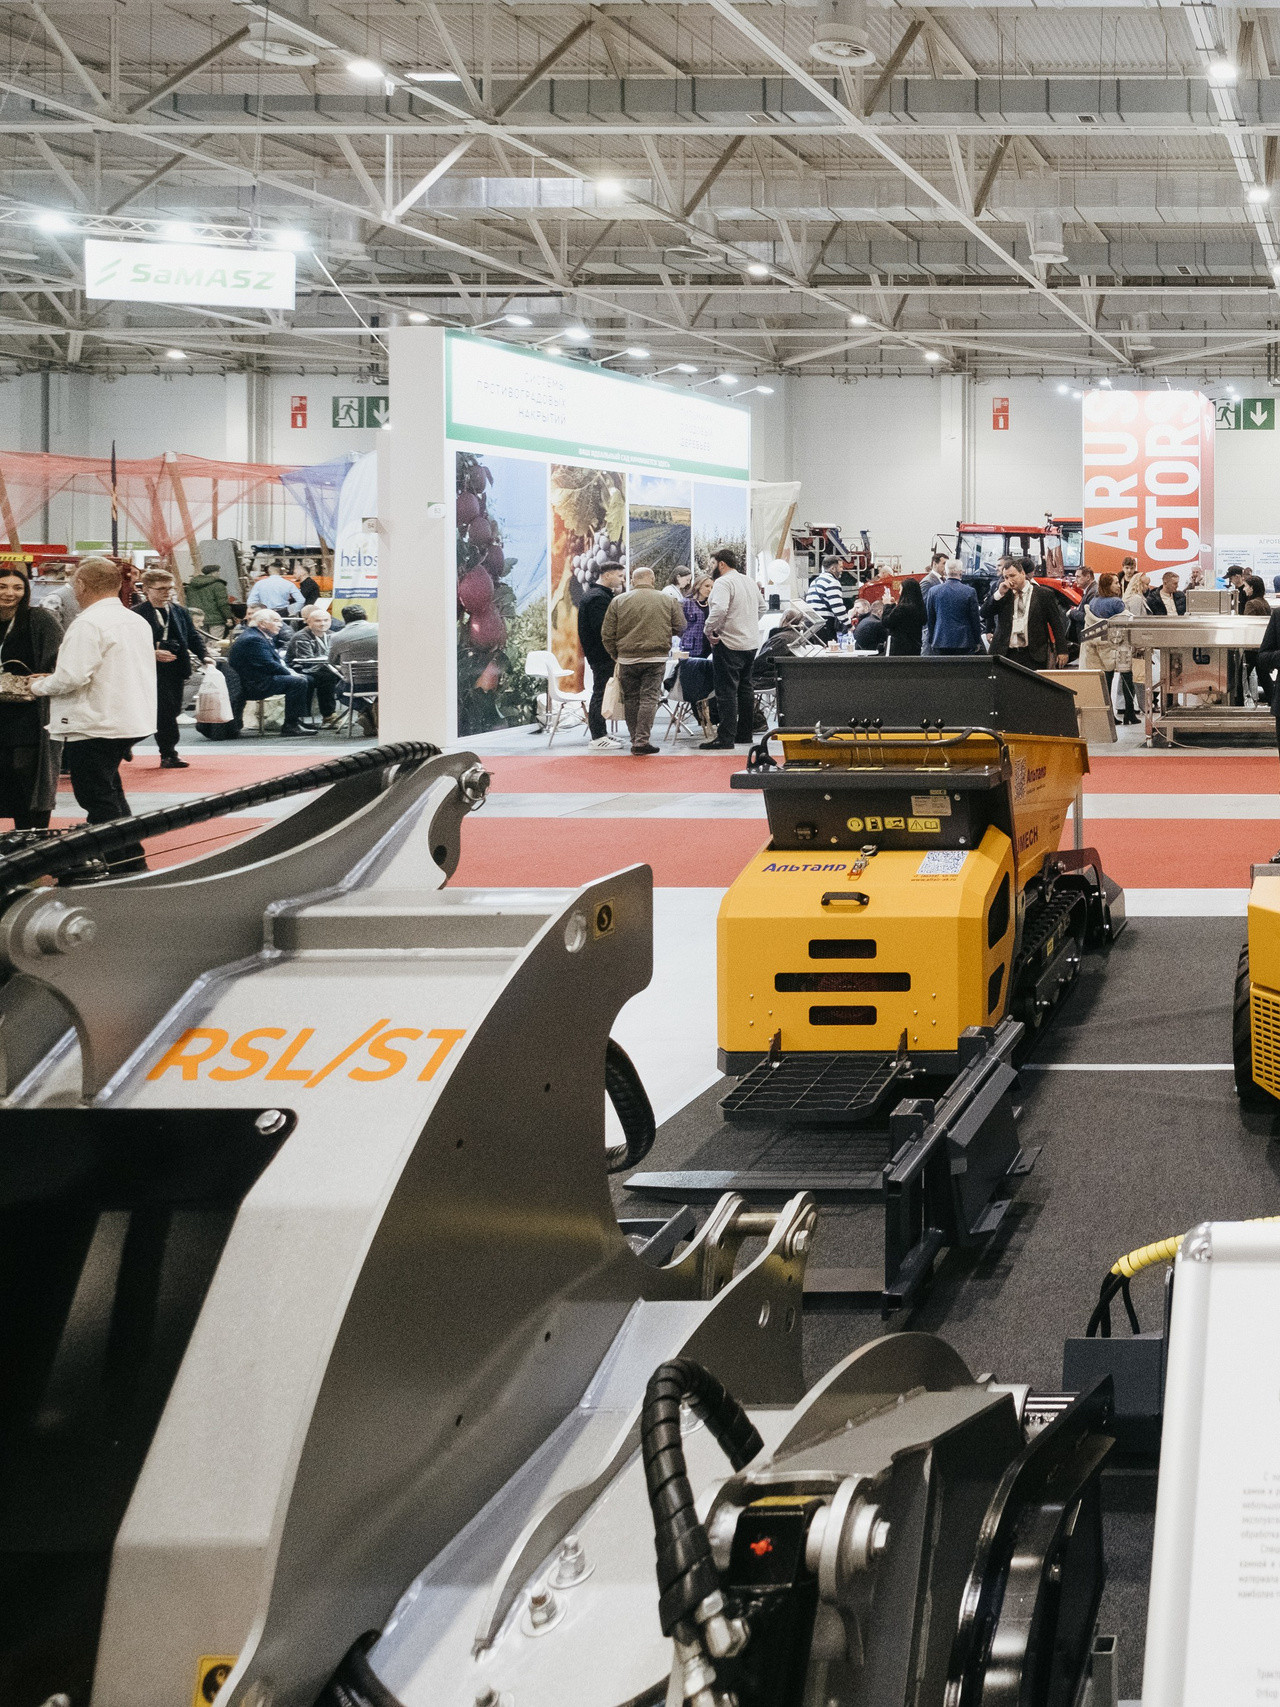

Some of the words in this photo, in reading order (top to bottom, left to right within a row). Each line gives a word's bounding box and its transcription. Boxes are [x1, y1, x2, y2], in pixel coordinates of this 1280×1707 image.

[130, 263, 277, 290] SaMASZ
[523, 371, 567, 391] СИСТЕМЫ
[476, 380, 567, 407] ПРОТИВОГРАДОВЫХ
[518, 408, 567, 425] НАКРЫТИЙ
[761, 862, 847, 873] Альтаир
[147, 1018, 466, 1089] RSL/ST
